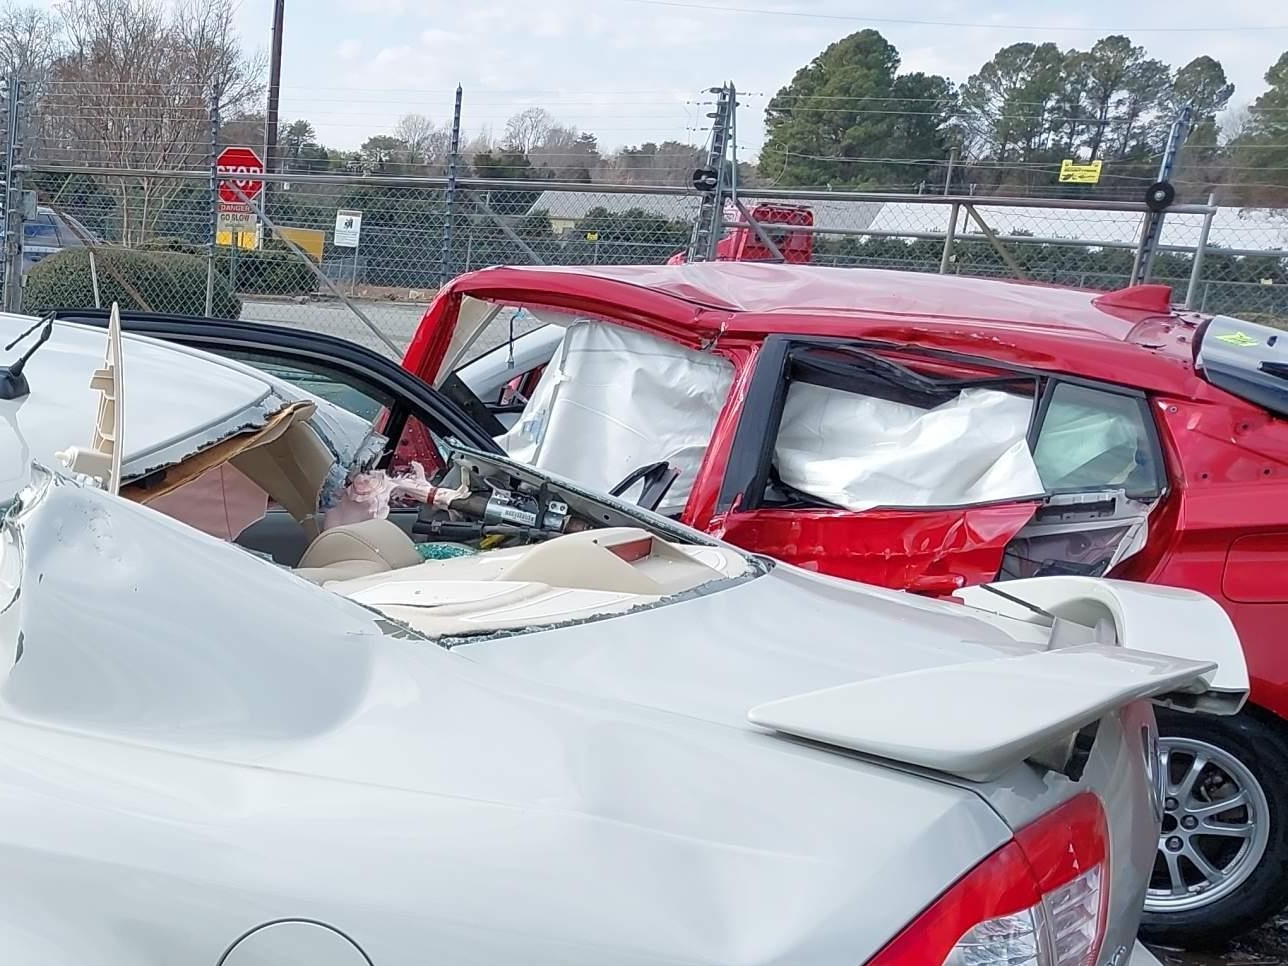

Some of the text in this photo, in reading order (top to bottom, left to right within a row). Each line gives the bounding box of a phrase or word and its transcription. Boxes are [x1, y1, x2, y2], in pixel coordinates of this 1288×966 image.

[216, 165, 260, 187] STOP
[220, 204, 250, 212] DANGER
[220, 213, 250, 222] GO SLOW
